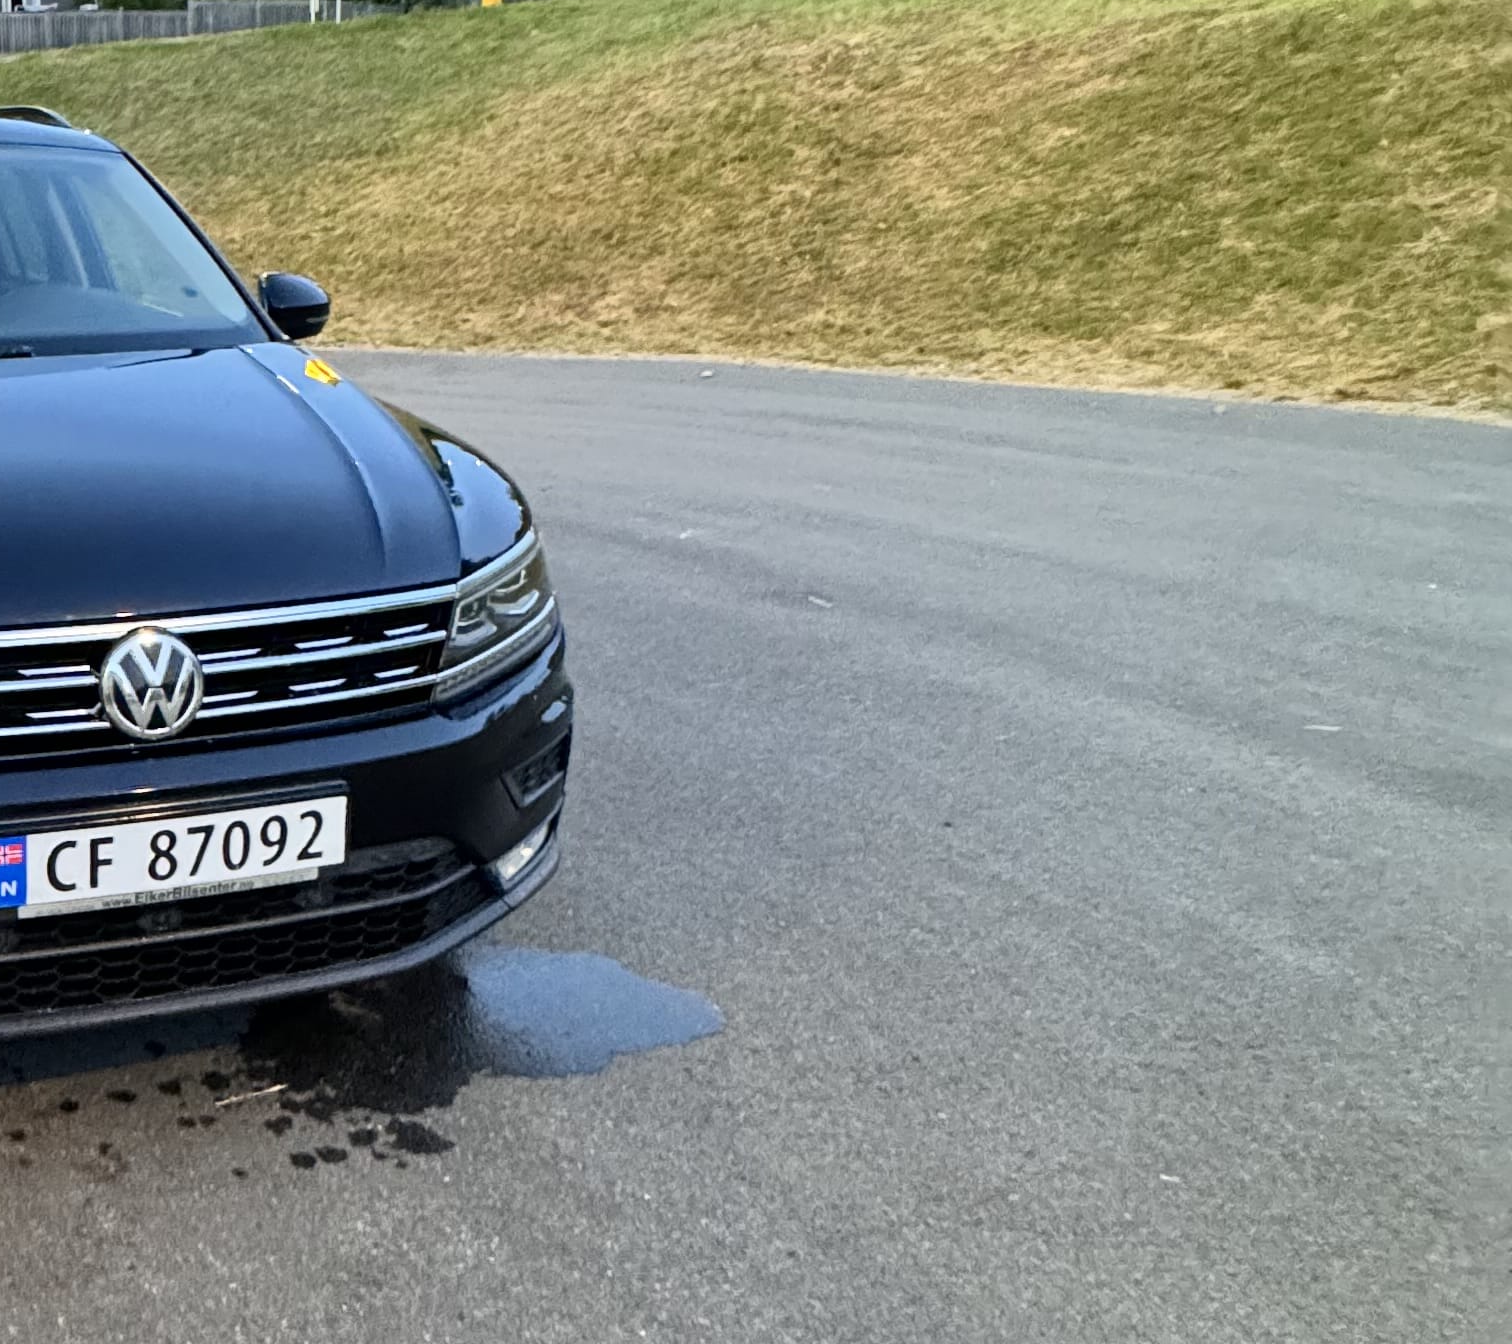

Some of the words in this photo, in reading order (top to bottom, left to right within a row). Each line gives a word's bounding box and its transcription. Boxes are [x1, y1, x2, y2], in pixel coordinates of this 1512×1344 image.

[46, 836, 114, 892] CF
[148, 809, 324, 882] 87092
[0, 879, 18, 897] N
